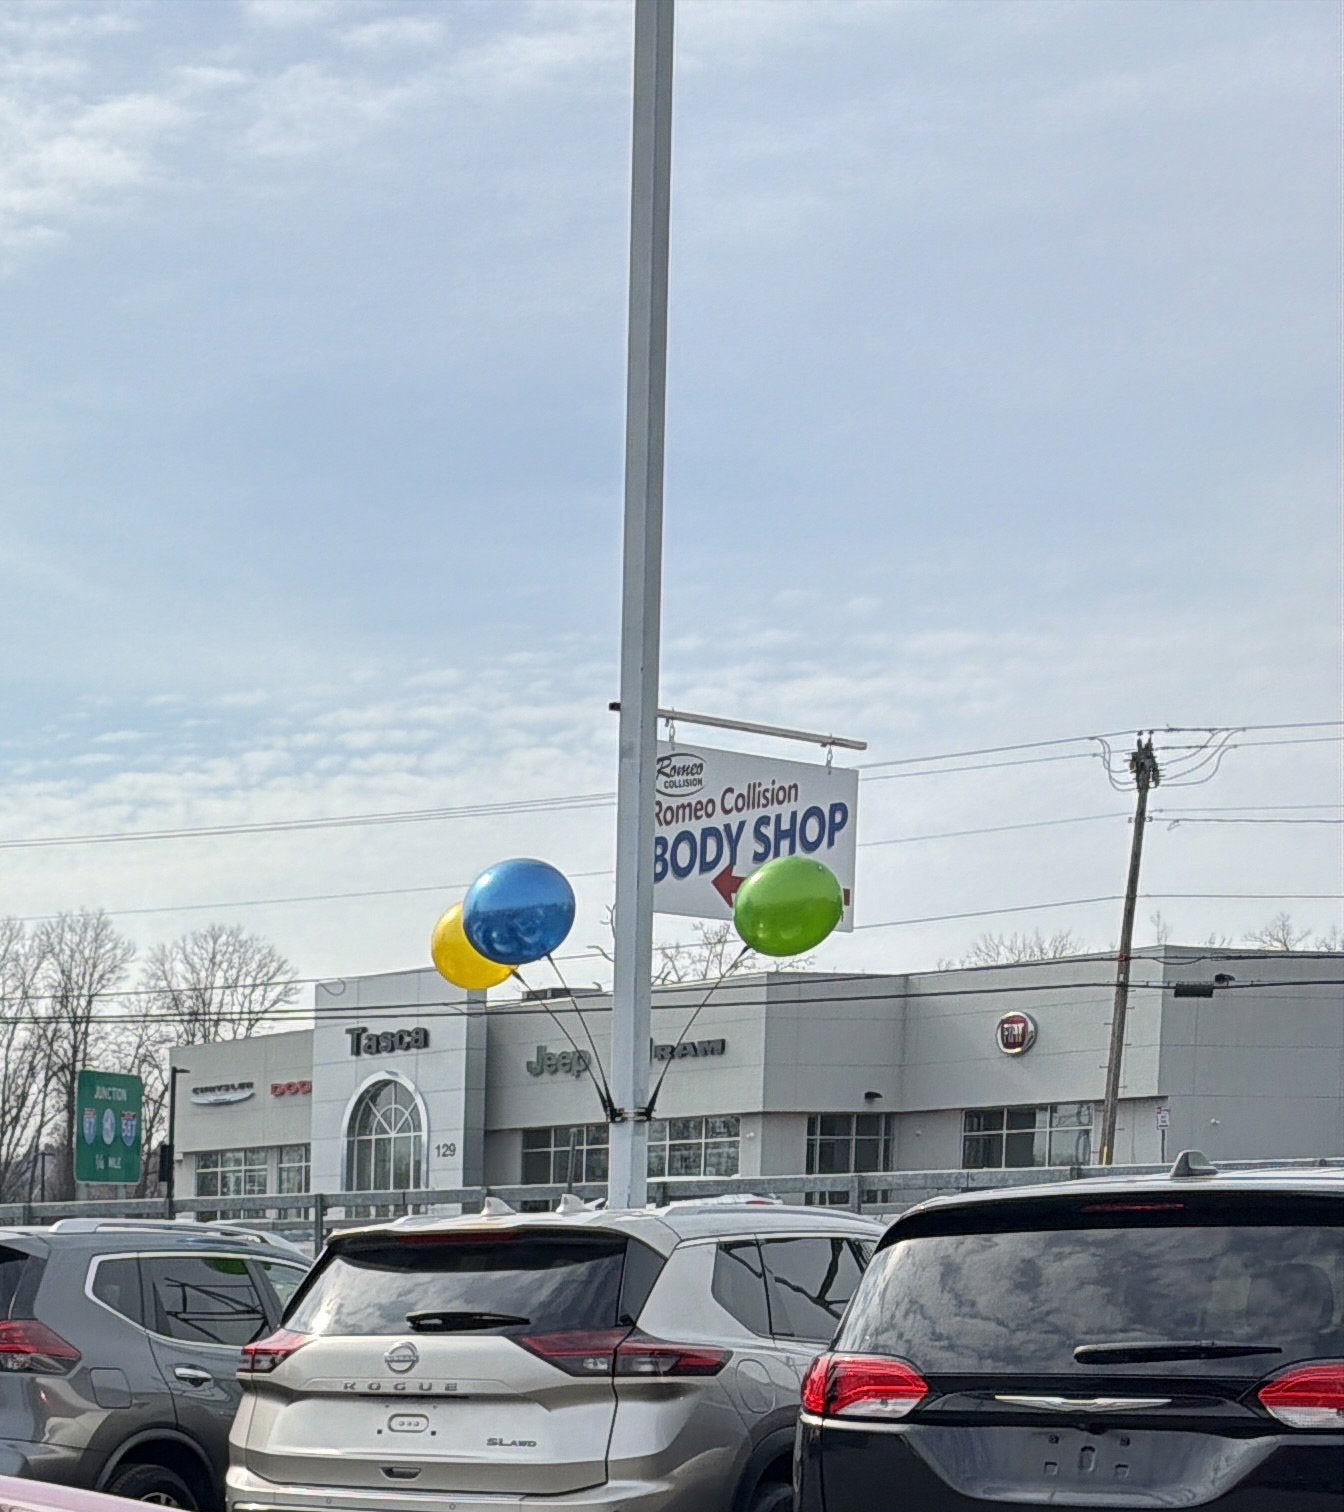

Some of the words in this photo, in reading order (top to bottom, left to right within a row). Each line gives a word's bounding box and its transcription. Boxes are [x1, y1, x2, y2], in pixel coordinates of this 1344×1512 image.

[656, 755, 704, 780] Romeo
[663, 776, 703, 790] COLLISION
[655, 797, 717, 828] Romeo
[720, 778, 799, 816] Collision
[654, 820, 747, 884] BODY
[752, 801, 850, 866] SHOP
[345, 1026, 431, 1056] Tasca
[526, 1044, 593, 1080] Jeep
[653, 1037, 727, 1061] RAM
[435, 1142, 457, 1158] 129
[343, 1382, 458, 1392] ROGUE
